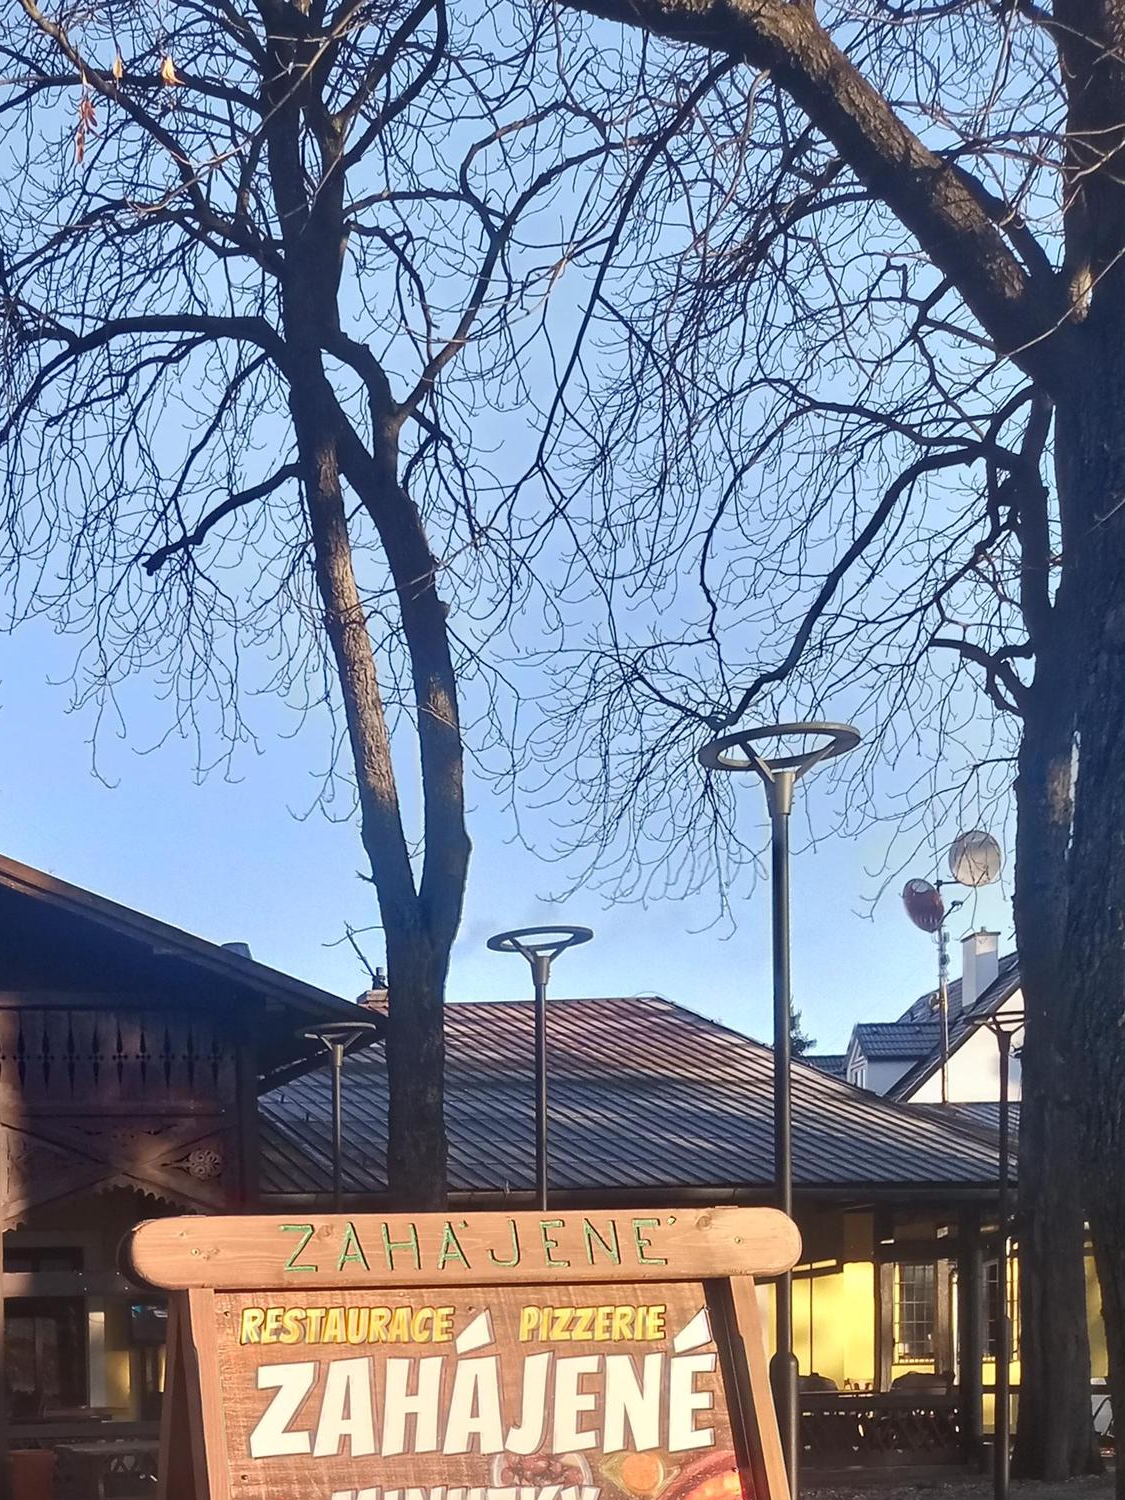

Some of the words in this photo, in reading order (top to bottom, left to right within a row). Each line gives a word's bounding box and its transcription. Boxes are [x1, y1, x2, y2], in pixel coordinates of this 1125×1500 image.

[239, 1305, 457, 1345] RESTAURACE
[517, 1304, 668, 1343] PIZZERIE
[249, 1305, 718, 1460] ZAHÁJENÉ
